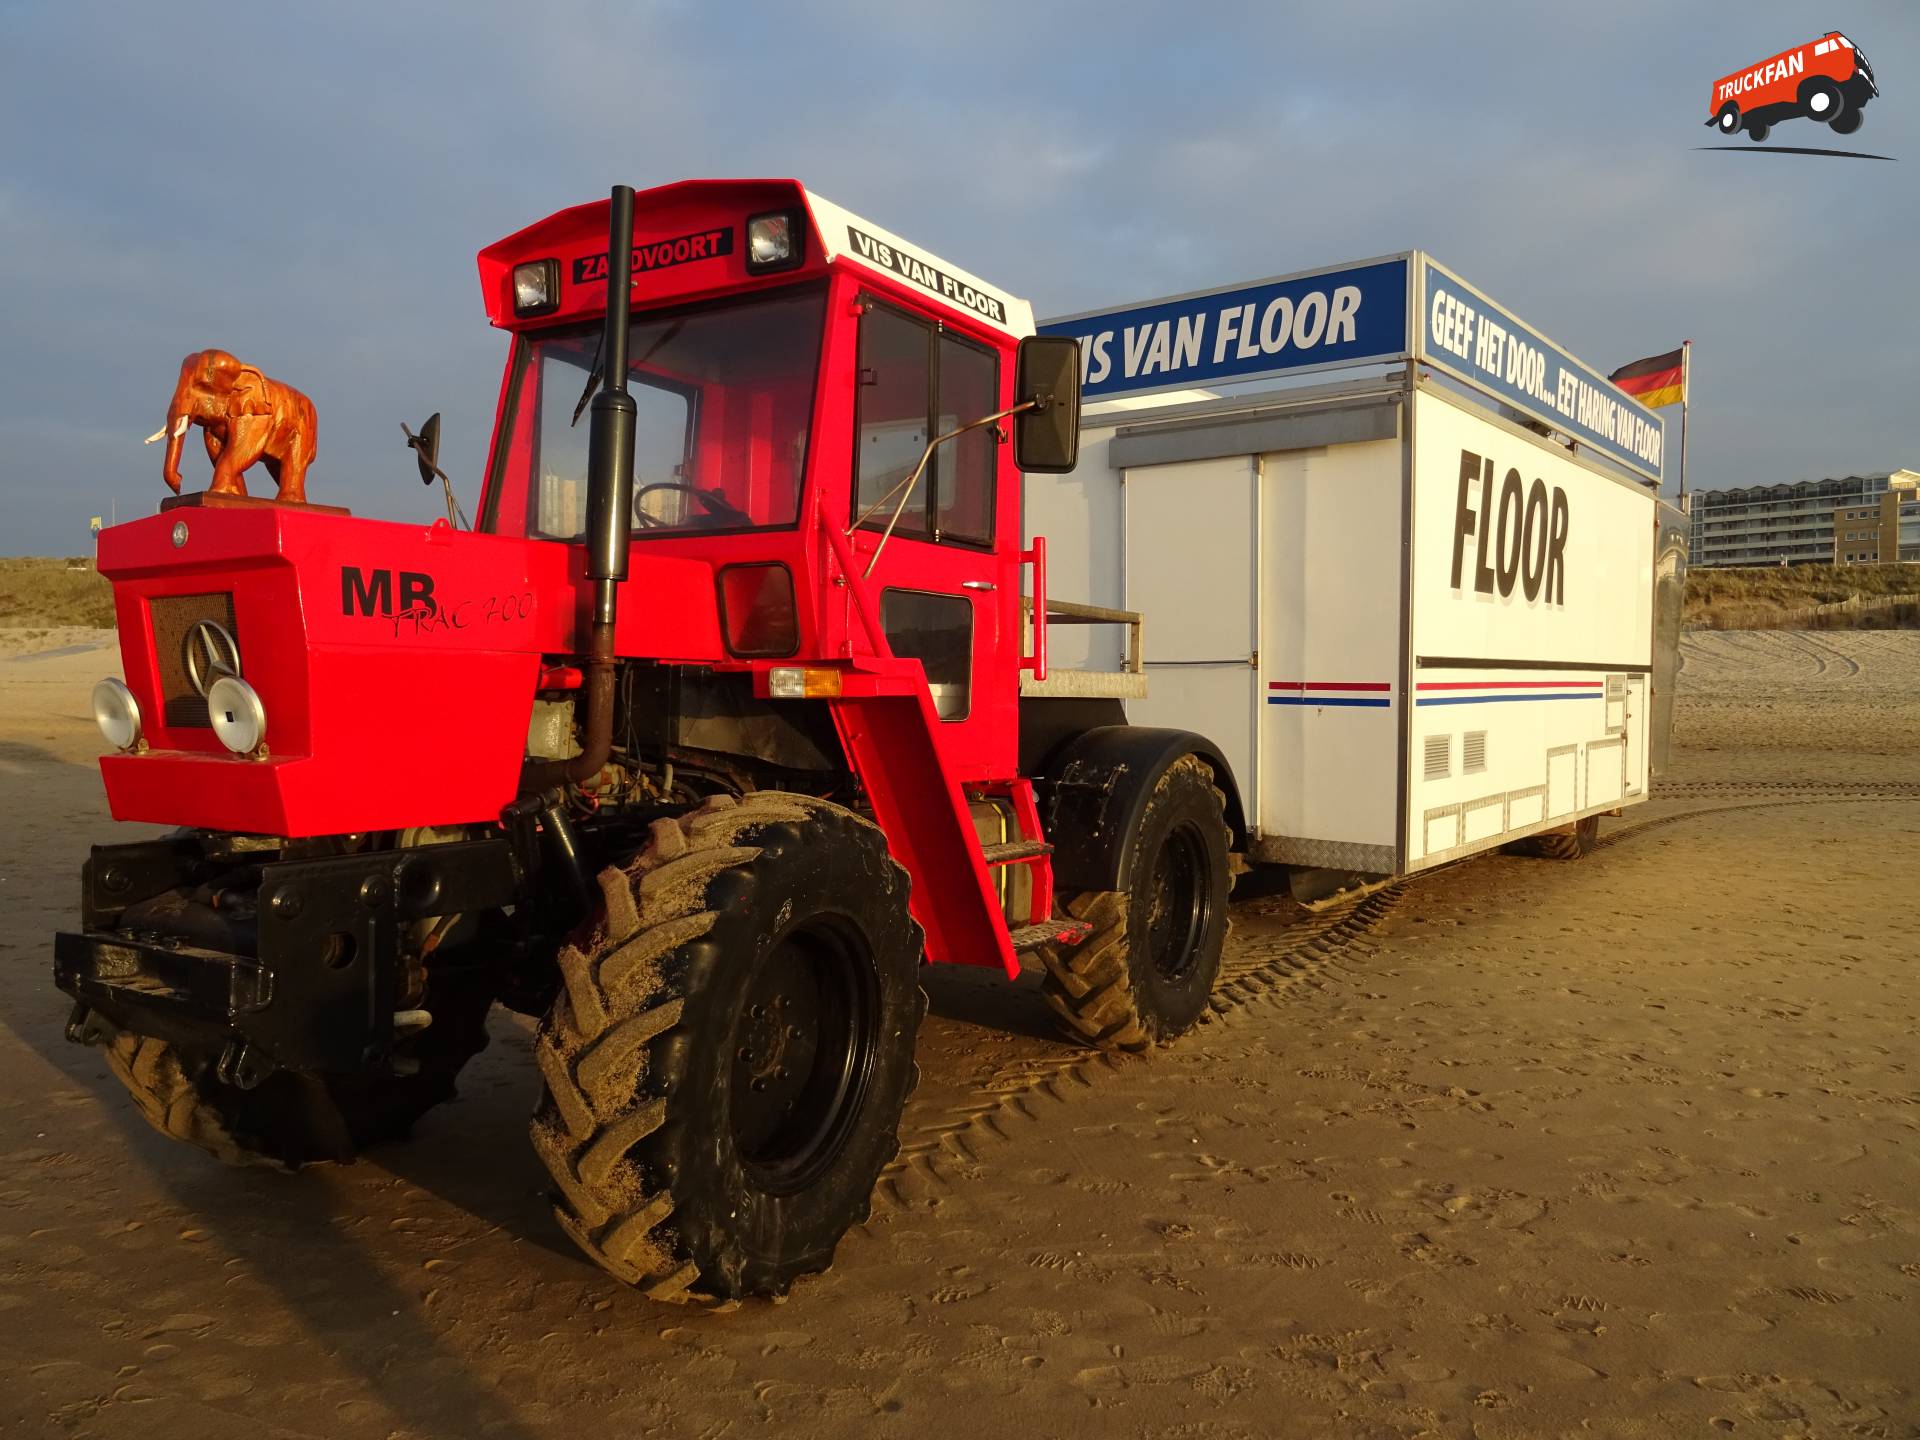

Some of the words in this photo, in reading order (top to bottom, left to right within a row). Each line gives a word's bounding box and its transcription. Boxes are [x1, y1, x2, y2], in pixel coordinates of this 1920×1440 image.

[581, 232, 722, 281] ZADVOORT
[855, 231, 893, 268] VIS
[896, 252, 938, 291] VAN
[942, 275, 1001, 321] FLOOR
[1075, 331, 1114, 386] IS
[1123, 313, 1206, 378] VAN
[1212, 286, 1362, 364] FLOOR
[1431, 289, 1475, 360] GEEF
[1475, 314, 1507, 378] HET
[1556, 367, 1579, 419] EET
[1577, 380, 1616, 441] HARING
[1616, 403, 1636, 452] VAN
[1634, 417, 1661, 468] FLOOR
[1450, 448, 1569, 606] FLOOR
[341, 566, 437, 620] MB
[382, 601, 472, 638] TRAC
[482, 592, 534, 625] 700
